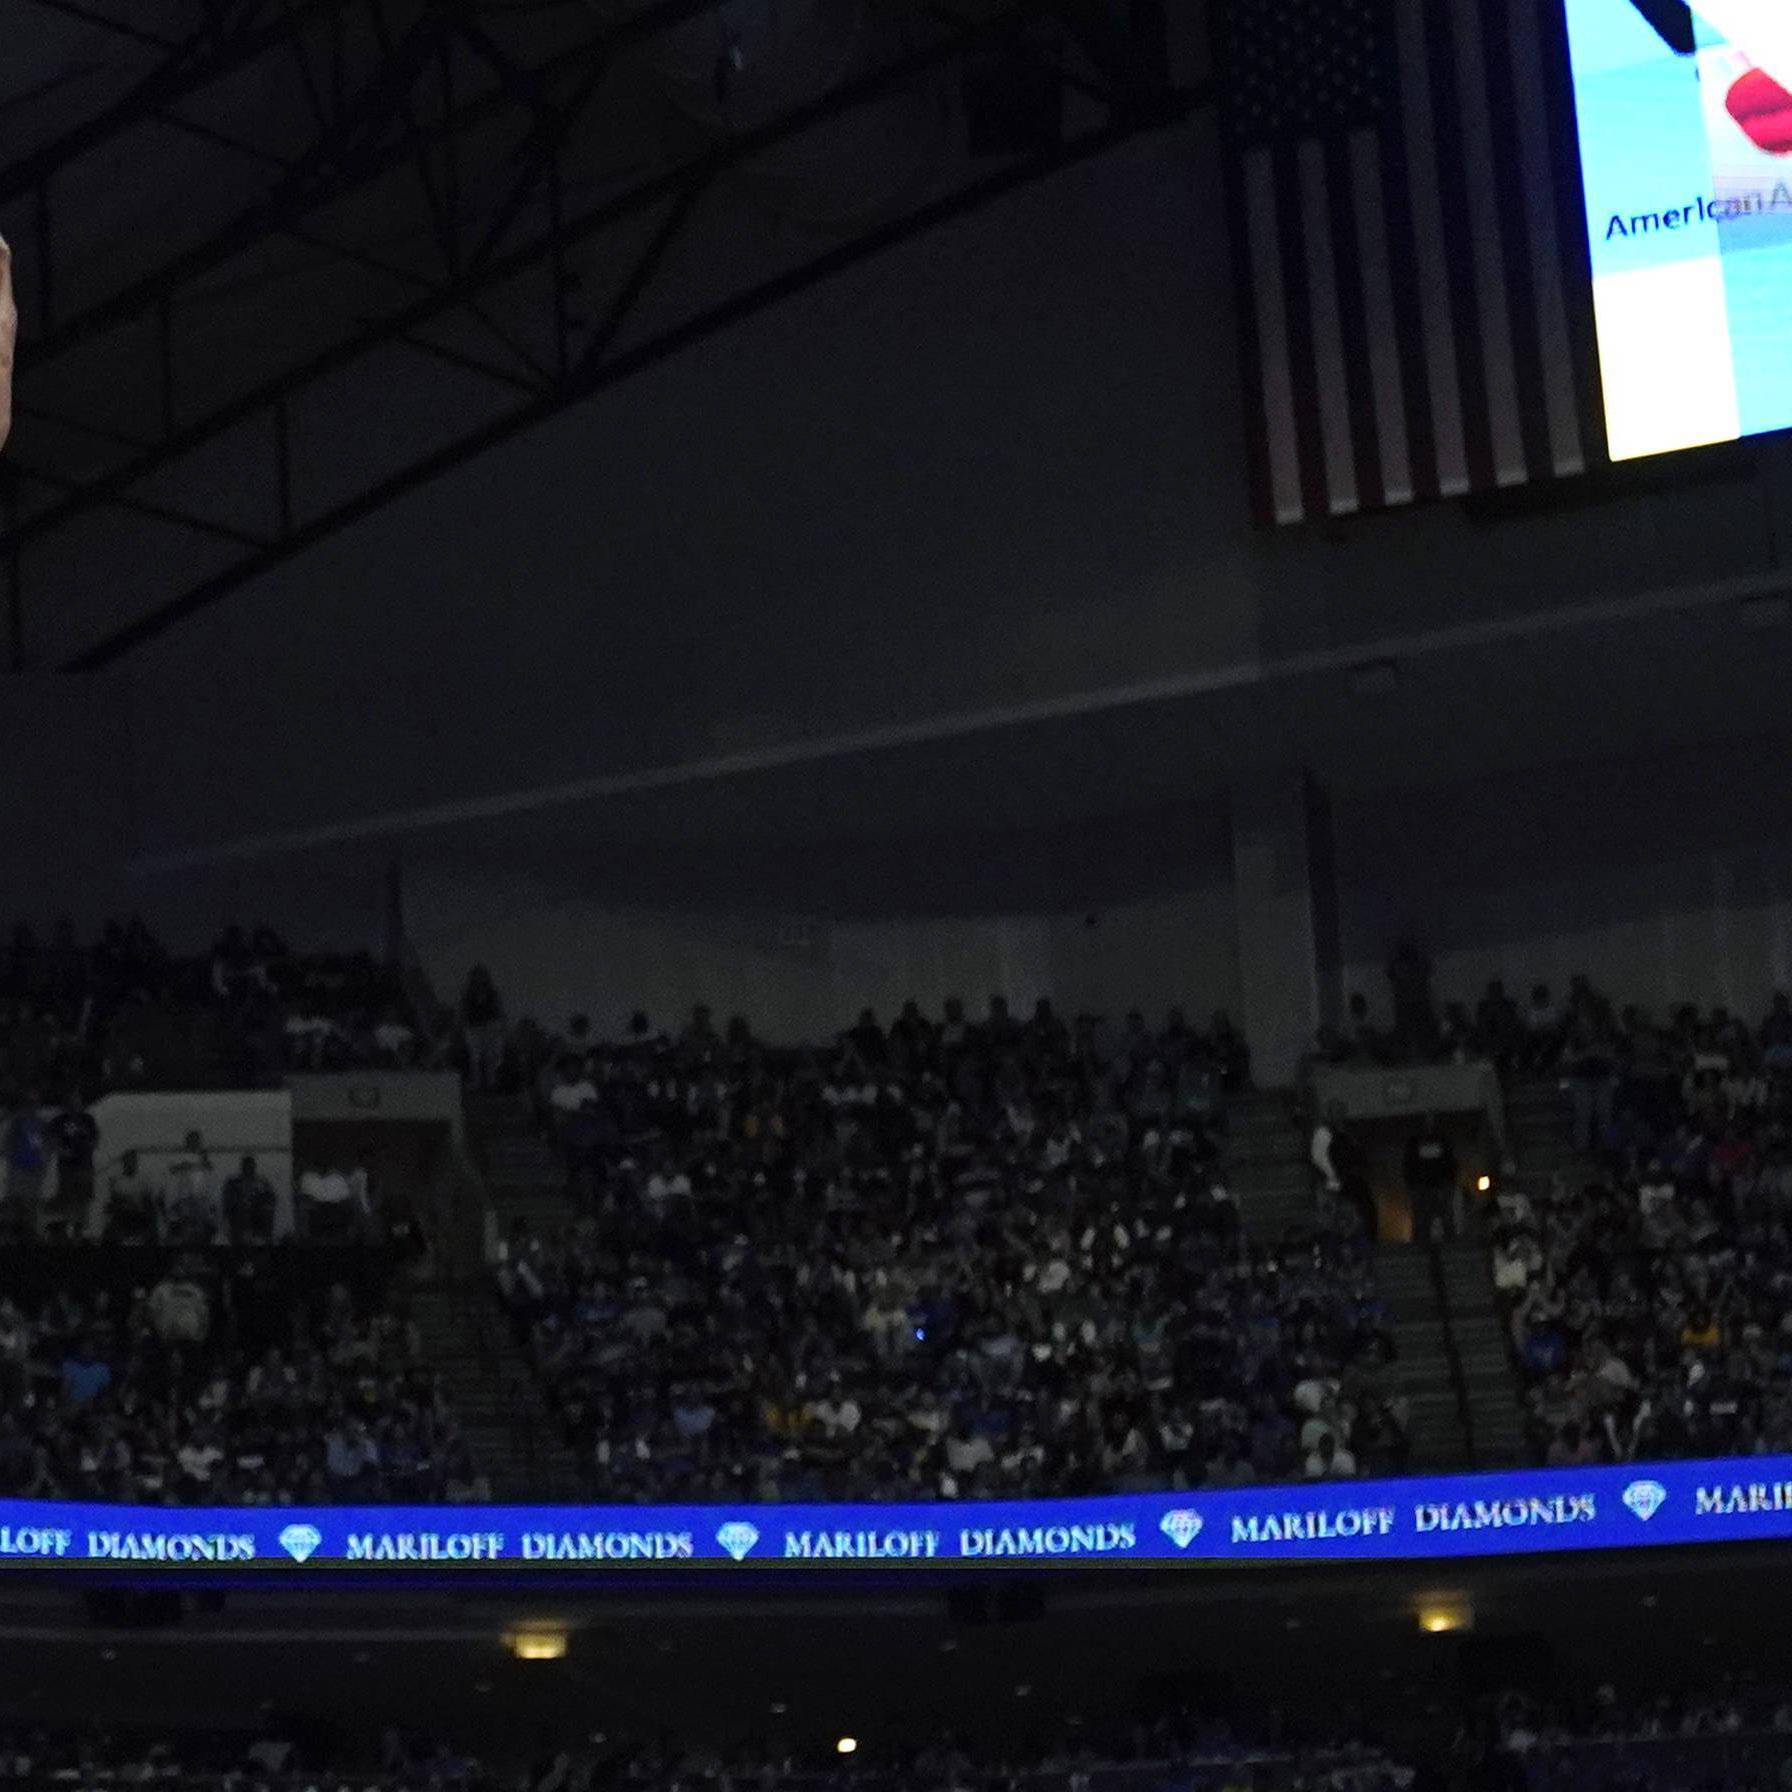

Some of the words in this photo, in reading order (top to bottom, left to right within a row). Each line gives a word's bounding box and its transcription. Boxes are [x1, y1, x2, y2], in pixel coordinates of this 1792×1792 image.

[1231, 1505, 1396, 1543] MARILOFF
[1416, 1493, 1597, 1534] DIAMONDS
[88, 1531, 257, 1561] DIAMONDS
[346, 1531, 506, 1561] MARILOFF
[520, 1530, 695, 1560] DIAMONDS
[784, 1530, 940, 1558] MARILOFF
[959, 1522, 1137, 1556] DIAMONDS
